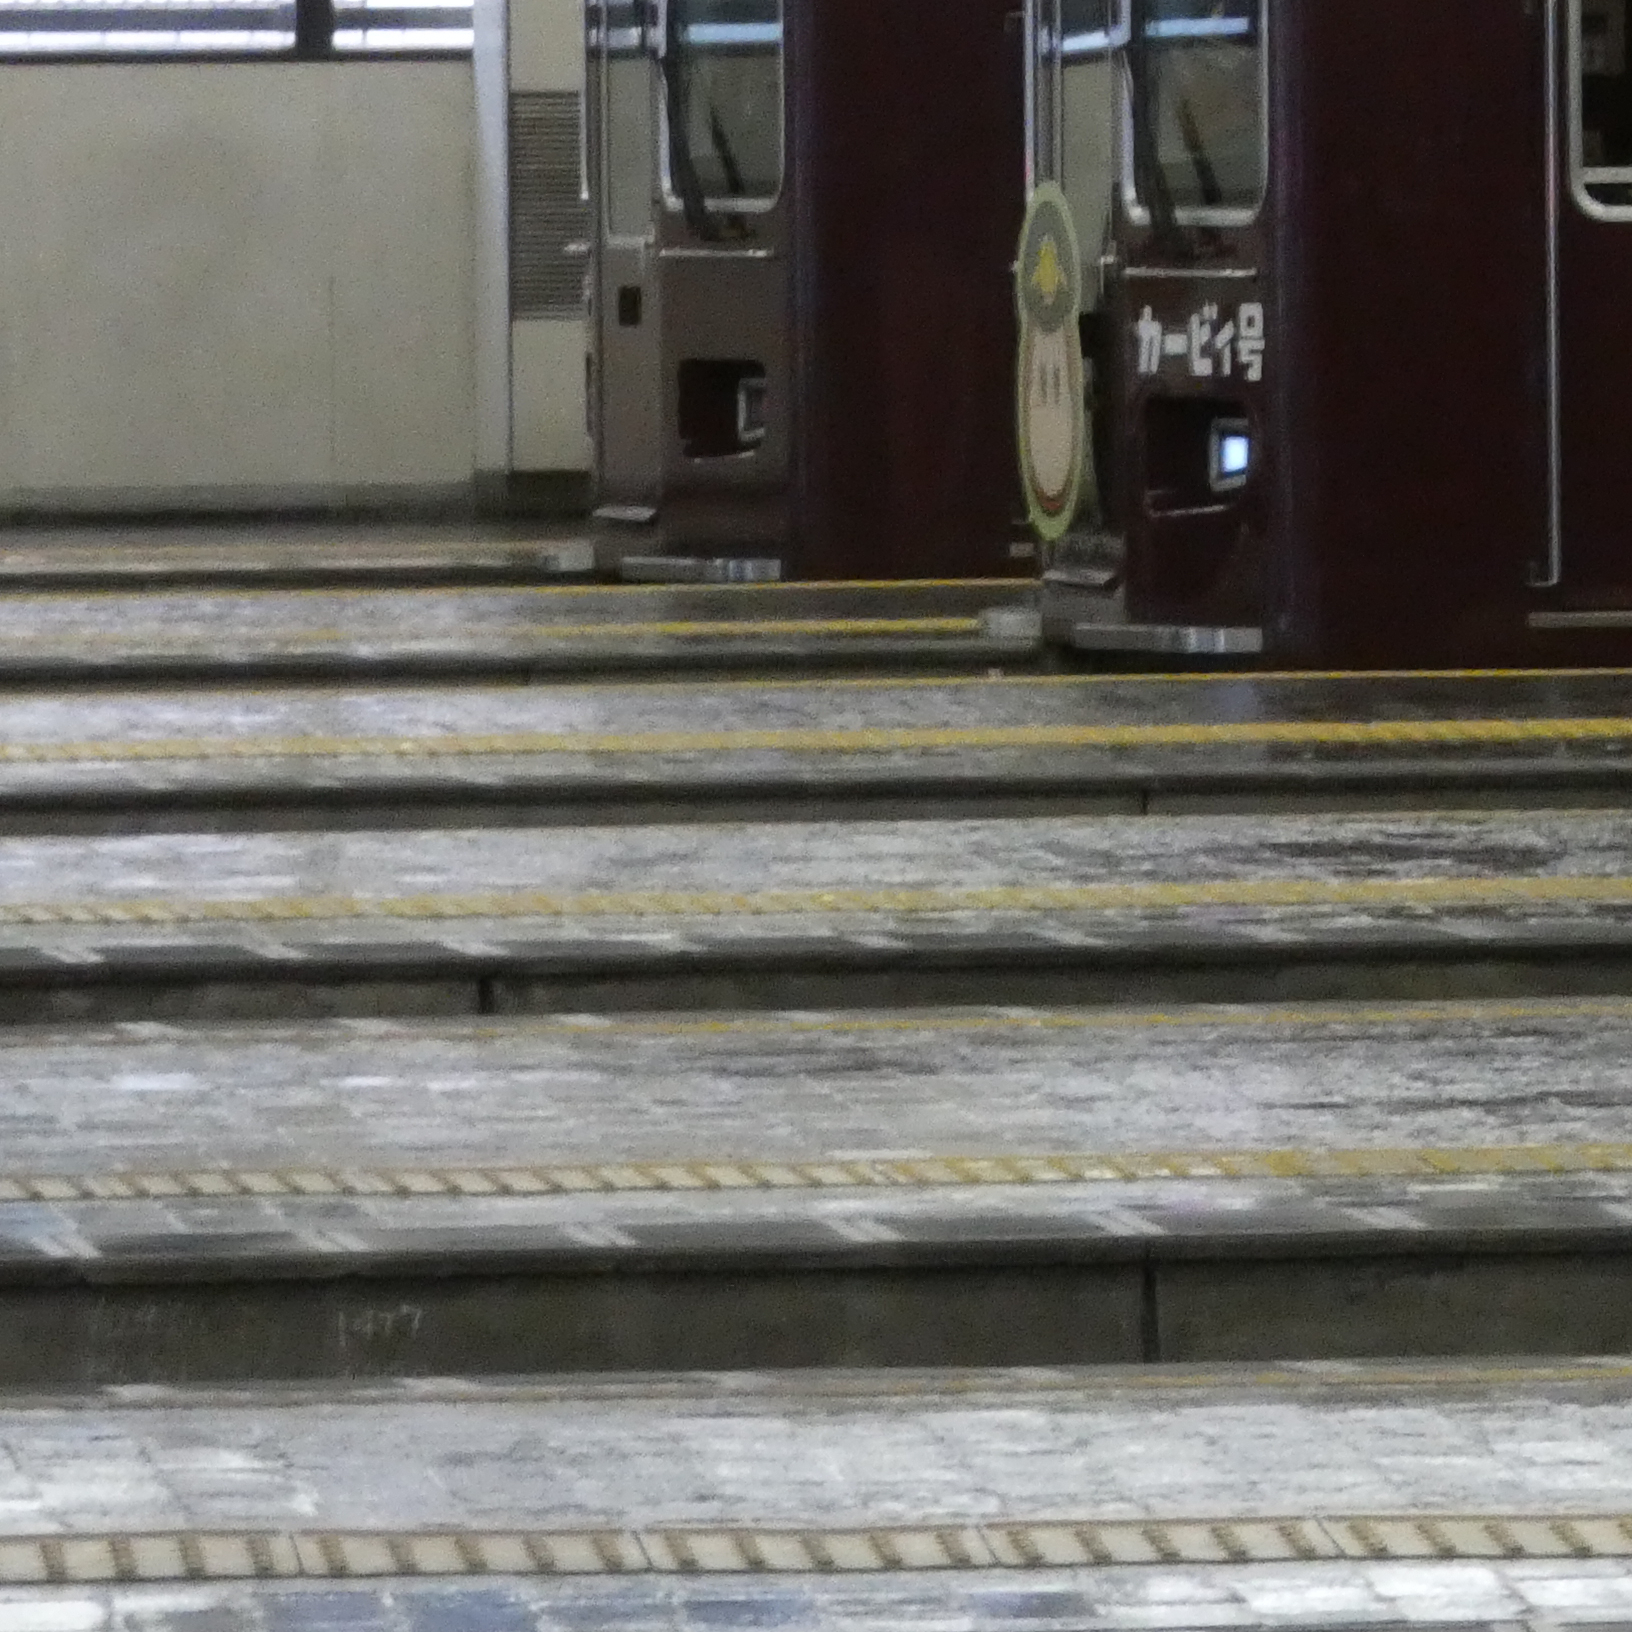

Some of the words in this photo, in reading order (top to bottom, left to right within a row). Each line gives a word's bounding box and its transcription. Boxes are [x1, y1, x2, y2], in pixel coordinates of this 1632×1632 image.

[1137, 298, 1266, 382] カービィ号
